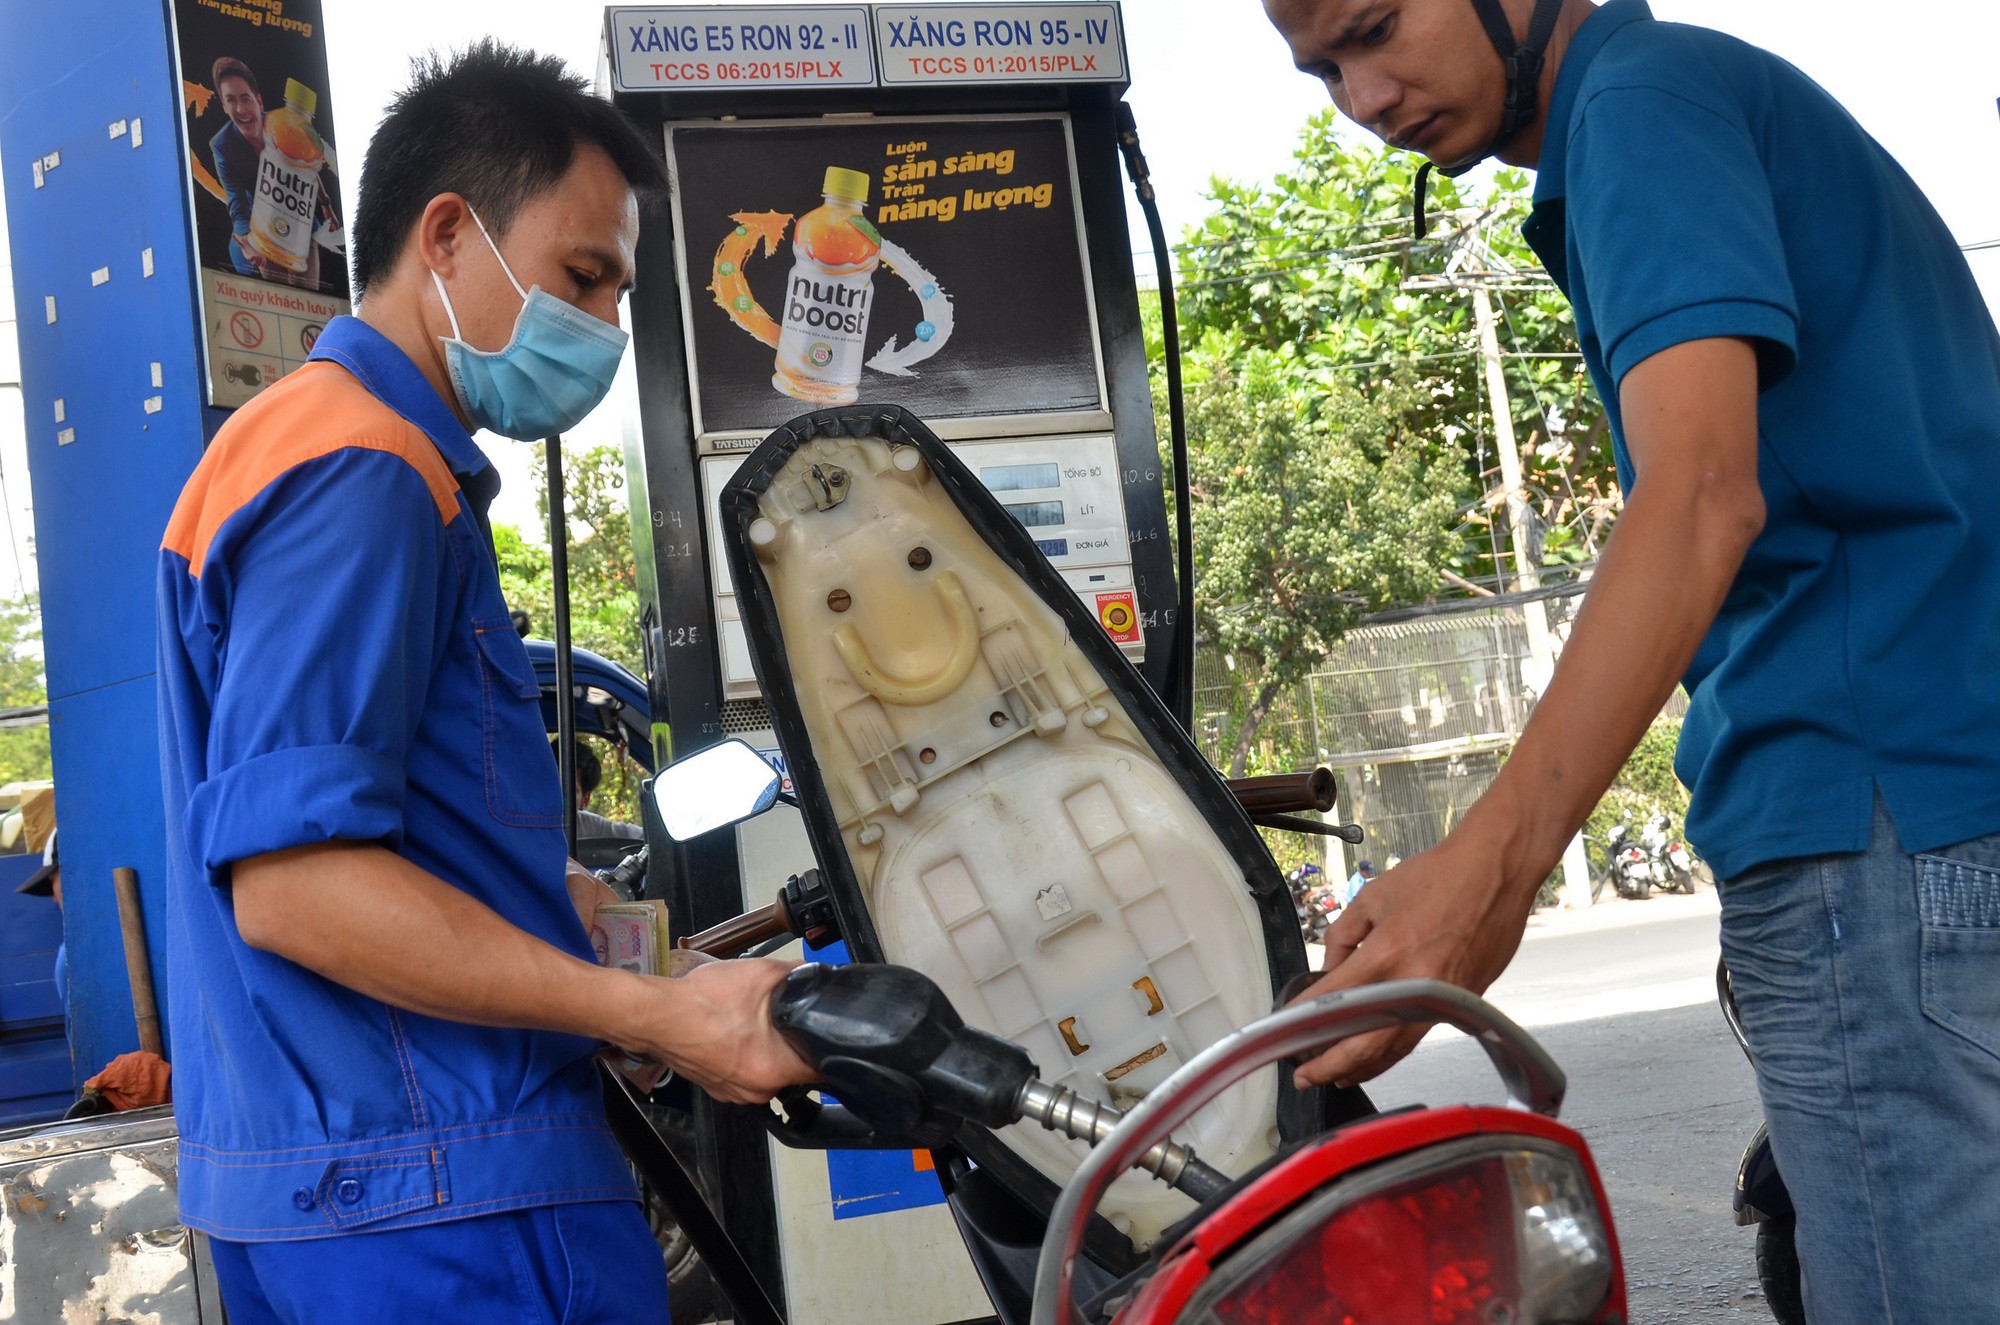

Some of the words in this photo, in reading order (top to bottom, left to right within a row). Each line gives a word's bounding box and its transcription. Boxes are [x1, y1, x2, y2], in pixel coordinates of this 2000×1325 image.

[220, 3, 262, 26] năng
[266, 11, 313, 38] lượng
[629, 19, 699, 52] XĂNG
[705, 25, 734, 51] E5
[740, 24, 792, 51] RON
[798, 24, 824, 50] 92
[845, 24, 858, 49] II
[888, 15, 966, 47] XĂNG
[974, 19, 1032, 46] RON
[650, 63, 710, 81] TCCS
[716, 60, 843, 80] 06:2015/PLX
[909, 57, 967, 74] TCCS
[973, 55, 1097, 73] 01:2015/PLX
[886, 140, 927, 156] Luôn
[263, 158, 314, 199] nutri
[882, 153, 937, 183] sẵn
[942, 149, 1015, 175] sàng
[260, 175, 312, 219] boost
[878, 196, 957, 224] năng
[963, 183, 1053, 211] lượng
[882, 183, 925, 199] Tràn
[216, 281, 237, 298] Xin
[241, 290, 265, 306] quý
[267, 291, 305, 312] khách
[308, 301, 326, 316] lưu
[793, 276, 868, 309] nutri
[788, 297, 865, 335] boost
[714, 438, 761, 449] TATSUNO
[1063, 466, 1087, 479] TỔNG
[1080, 503, 1095, 515] LÍT
[1075, 539, 1094, 550] ĐƠN
[1095, 539, 1109, 549] GIÁ
[1097, 593, 1131, 602] EMERGENCY
